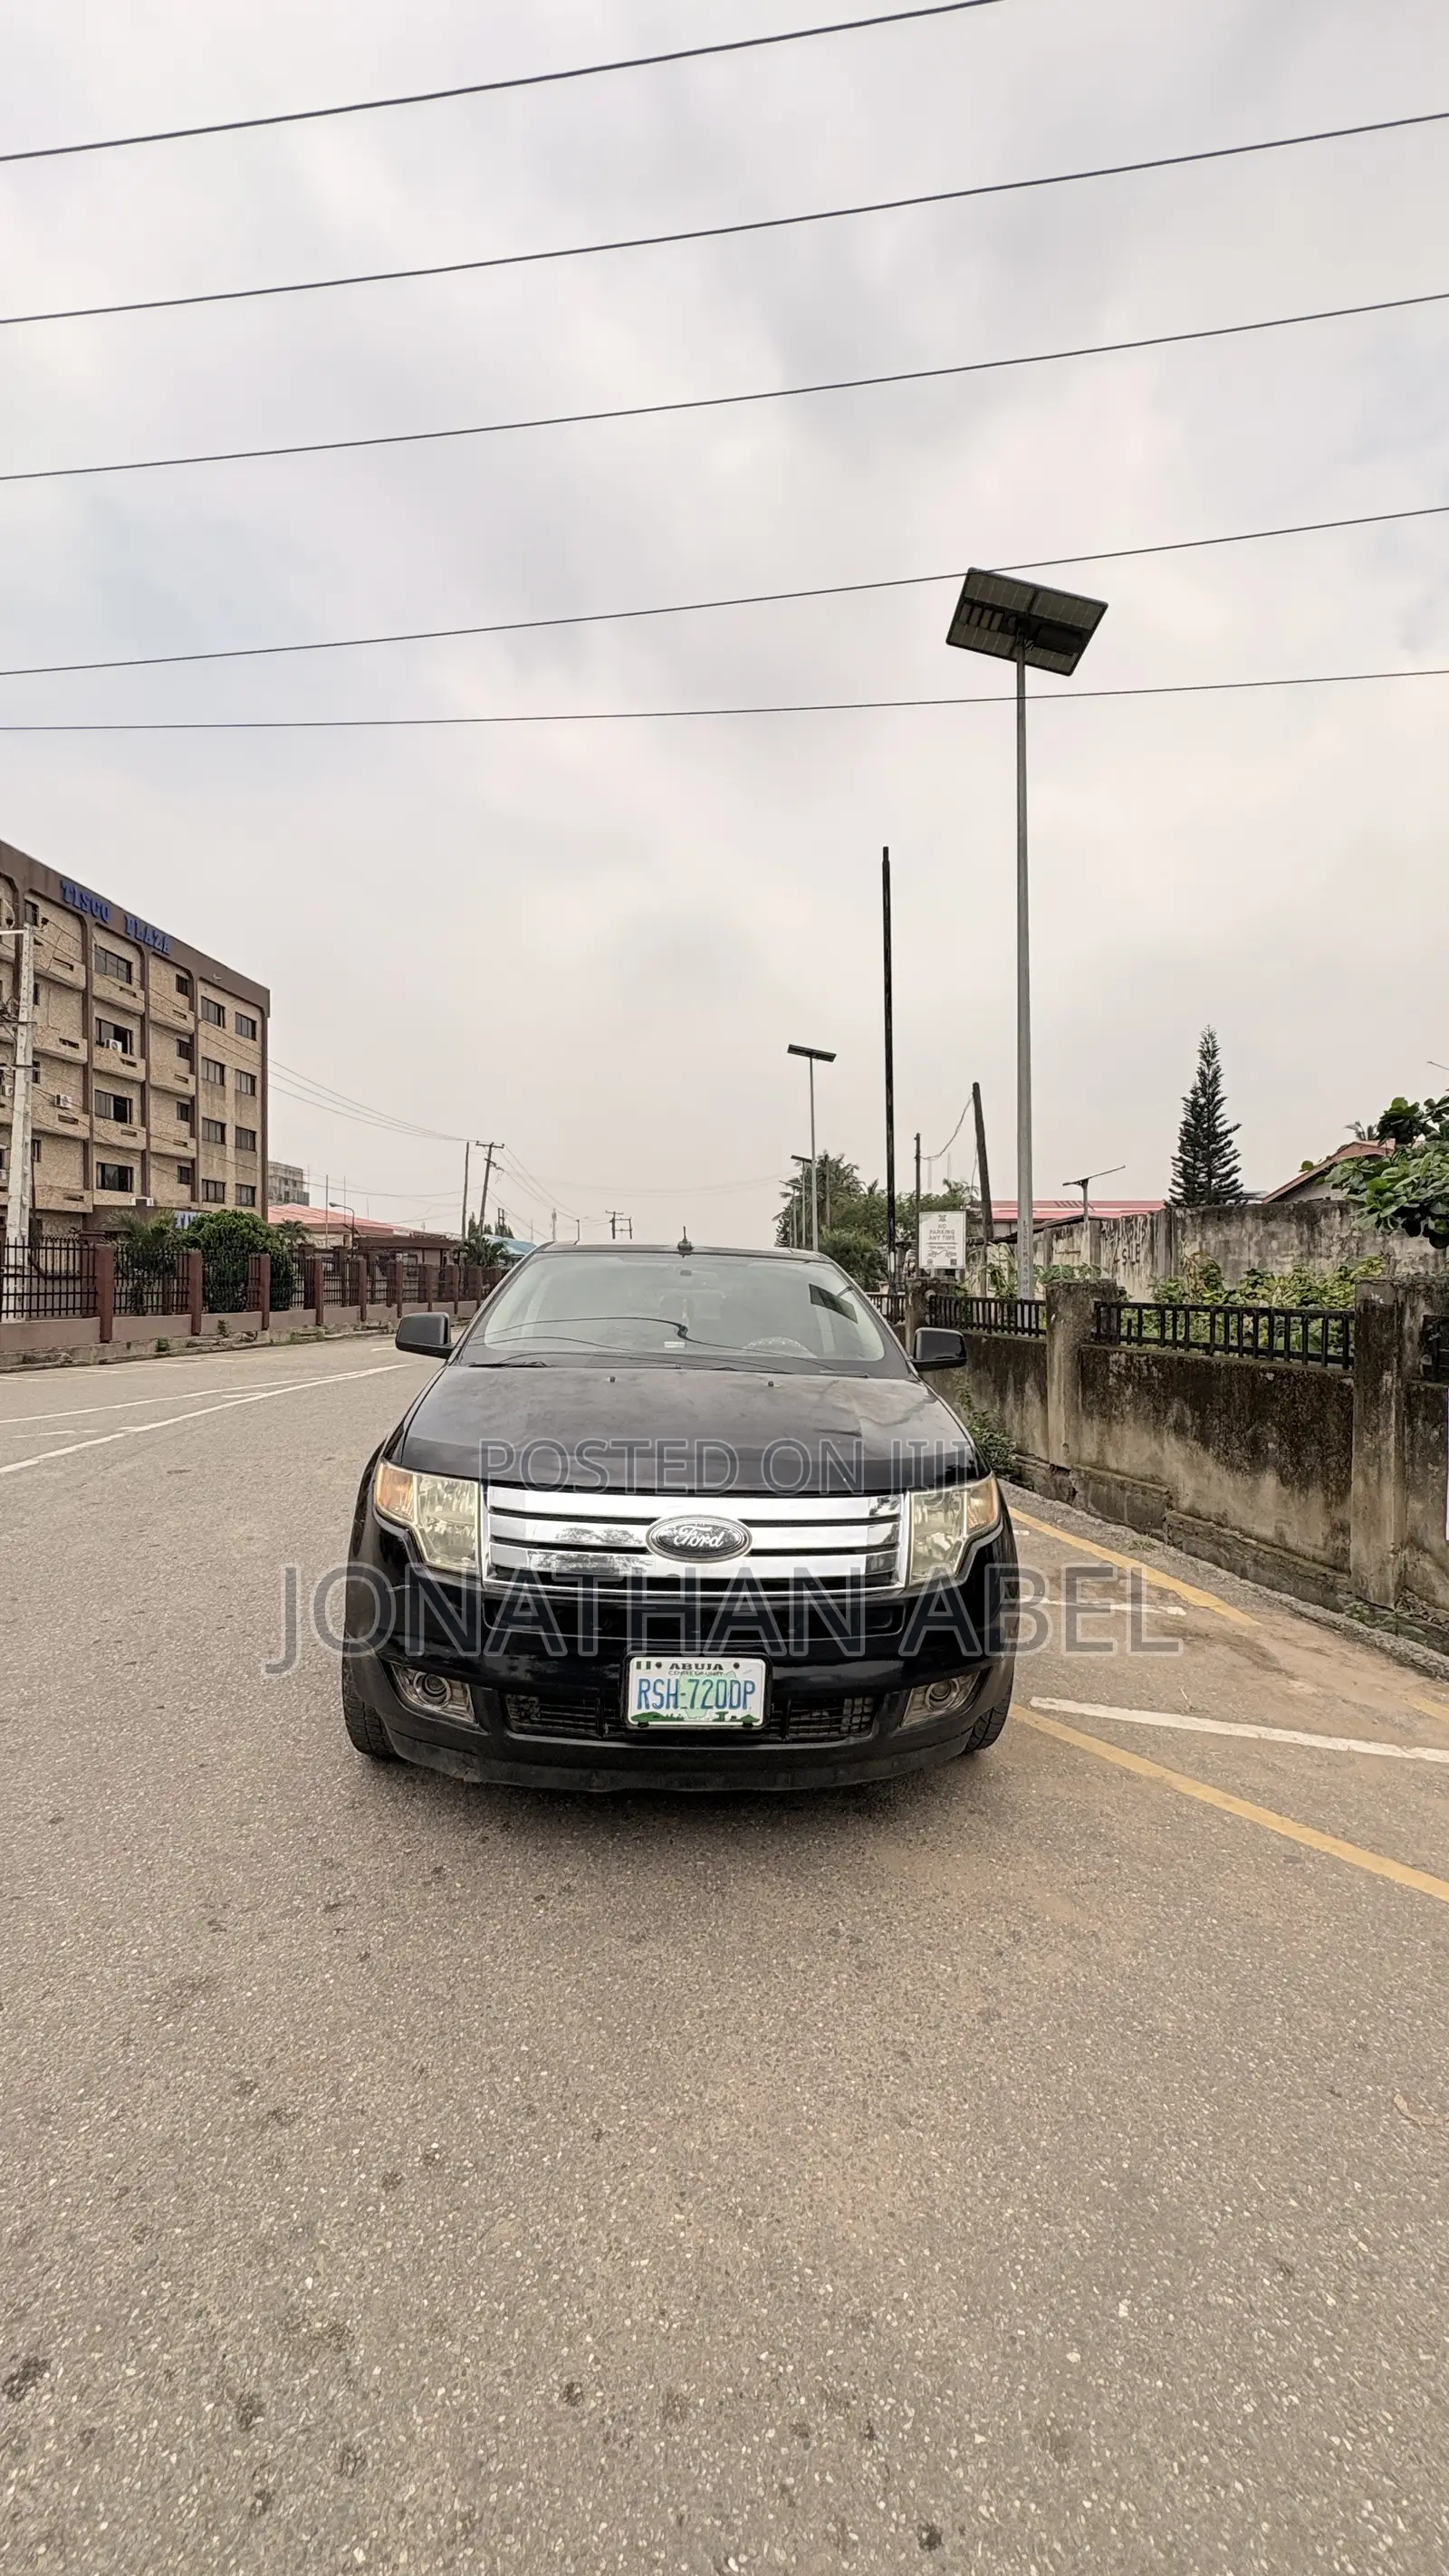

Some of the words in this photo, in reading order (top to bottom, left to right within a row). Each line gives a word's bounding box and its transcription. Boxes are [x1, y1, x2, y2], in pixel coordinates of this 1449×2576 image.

[124, 914, 170, 956] PLAZA
[674, 1525, 724, 1547] Ford
[669, 1662, 724, 1671] ABUJA
